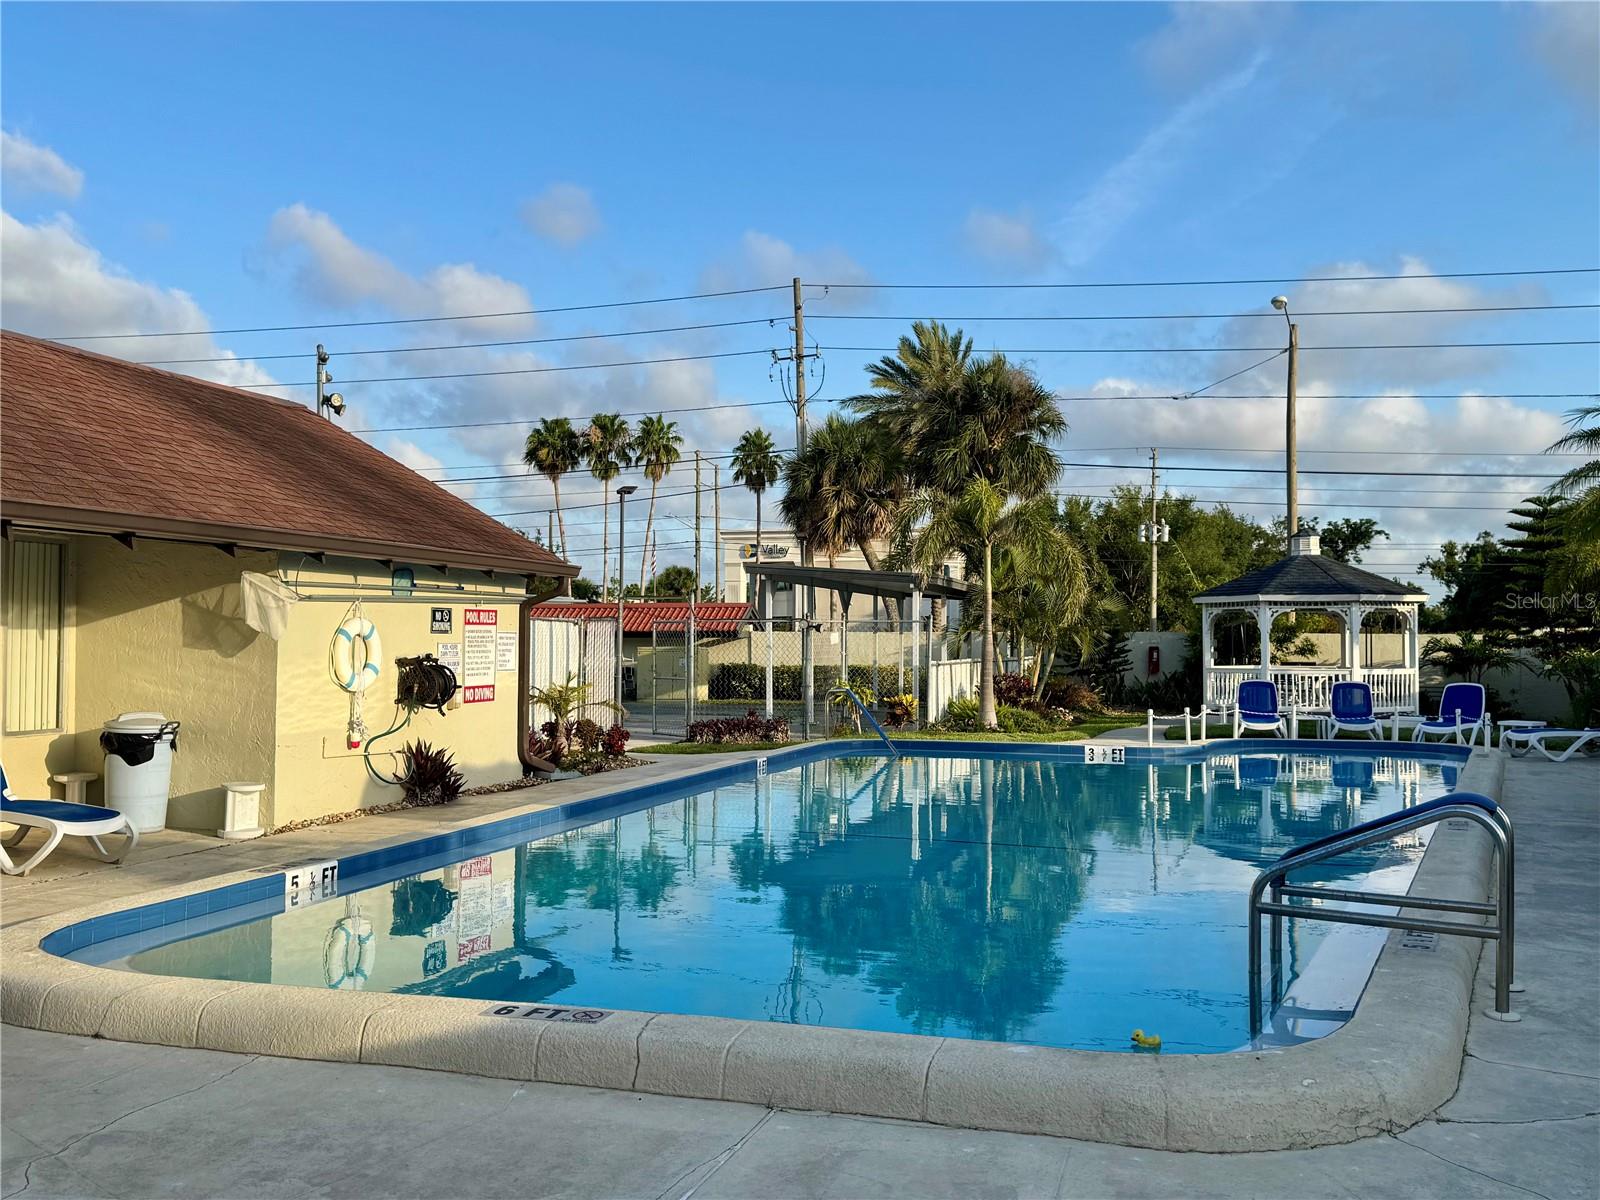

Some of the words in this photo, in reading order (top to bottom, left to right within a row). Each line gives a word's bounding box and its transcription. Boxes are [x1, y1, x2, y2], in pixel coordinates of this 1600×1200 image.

[761, 544, 790, 558] Valley
[435, 611, 442, 621] NO
[466, 611, 480, 623] POOL
[480, 611, 496, 624] RULES
[432, 621, 451, 631] SMOKING
[465, 688, 474, 702] NO
[474, 687, 494, 701] DIVING
[291, 874, 299, 890] 5
[493, 1005, 520, 1016] 6
[522, 1007, 571, 1019] FT
